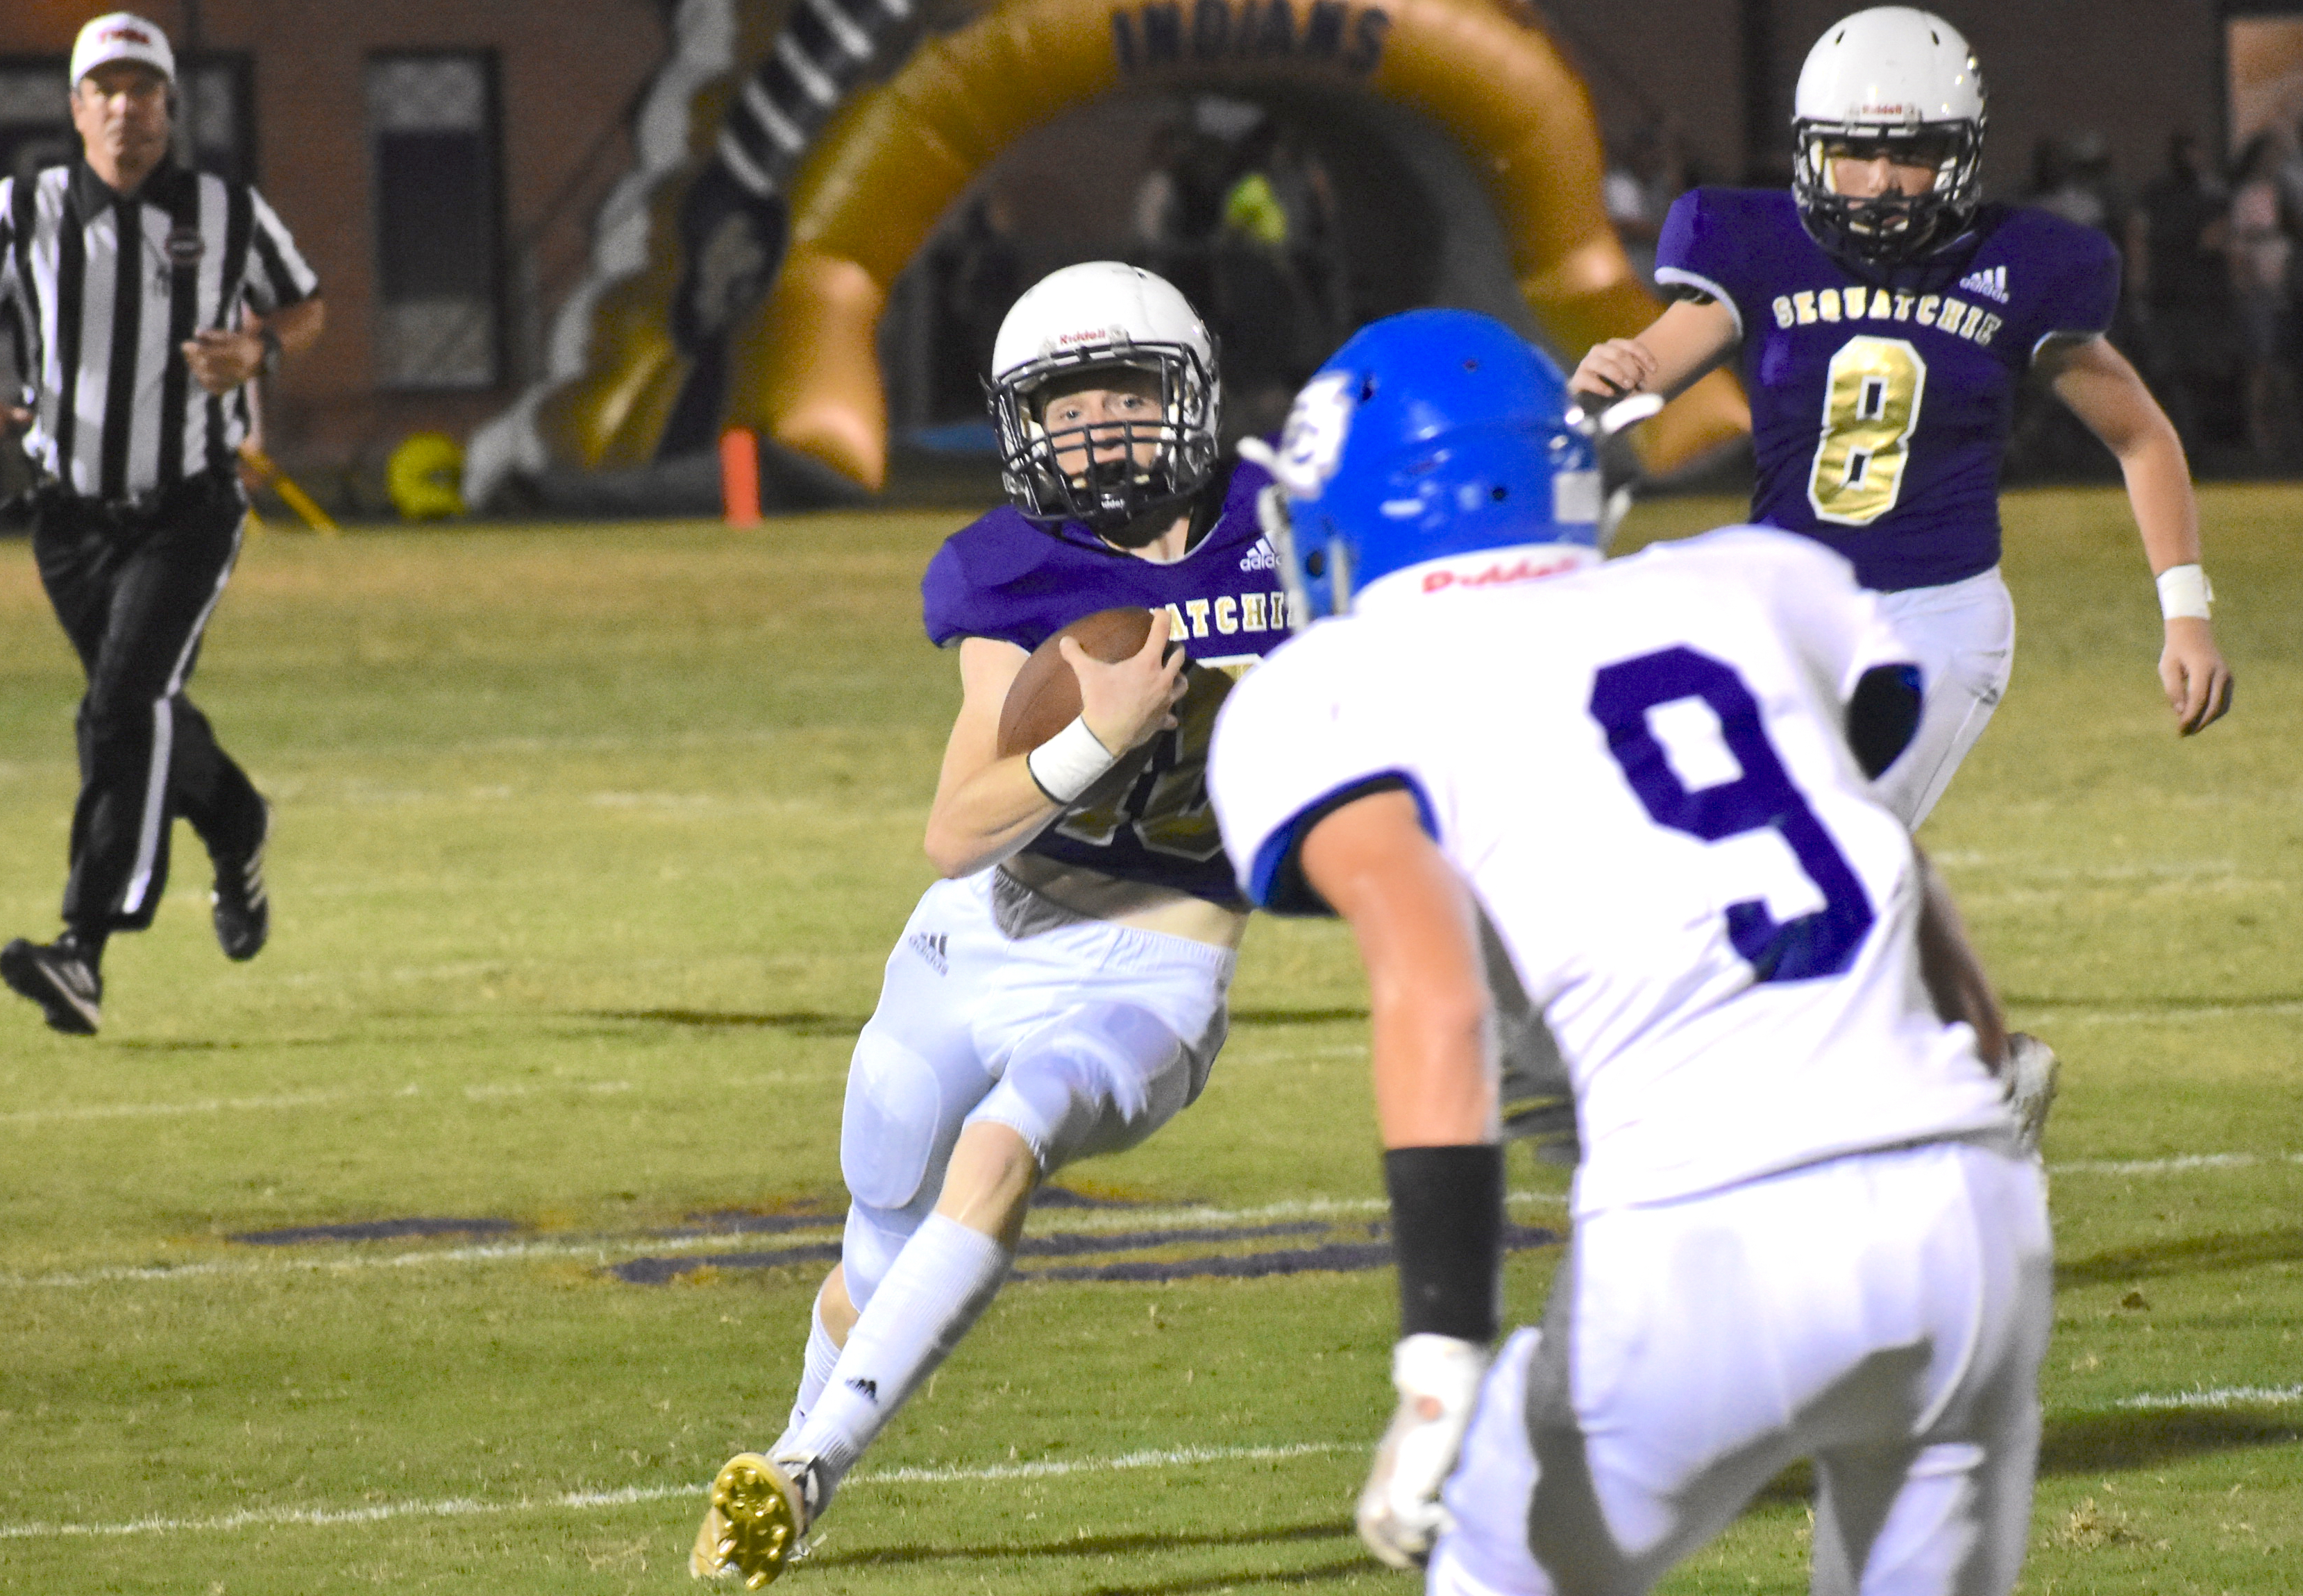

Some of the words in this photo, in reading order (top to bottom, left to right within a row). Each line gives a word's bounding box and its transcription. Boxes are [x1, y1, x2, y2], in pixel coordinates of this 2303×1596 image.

[1112, 0, 1390, 74] INDIANS
[1772, 287, 2002, 346] SEQUATCHIE
[1807, 334, 1927, 527] 8
[1585, 641, 1880, 984] 9
